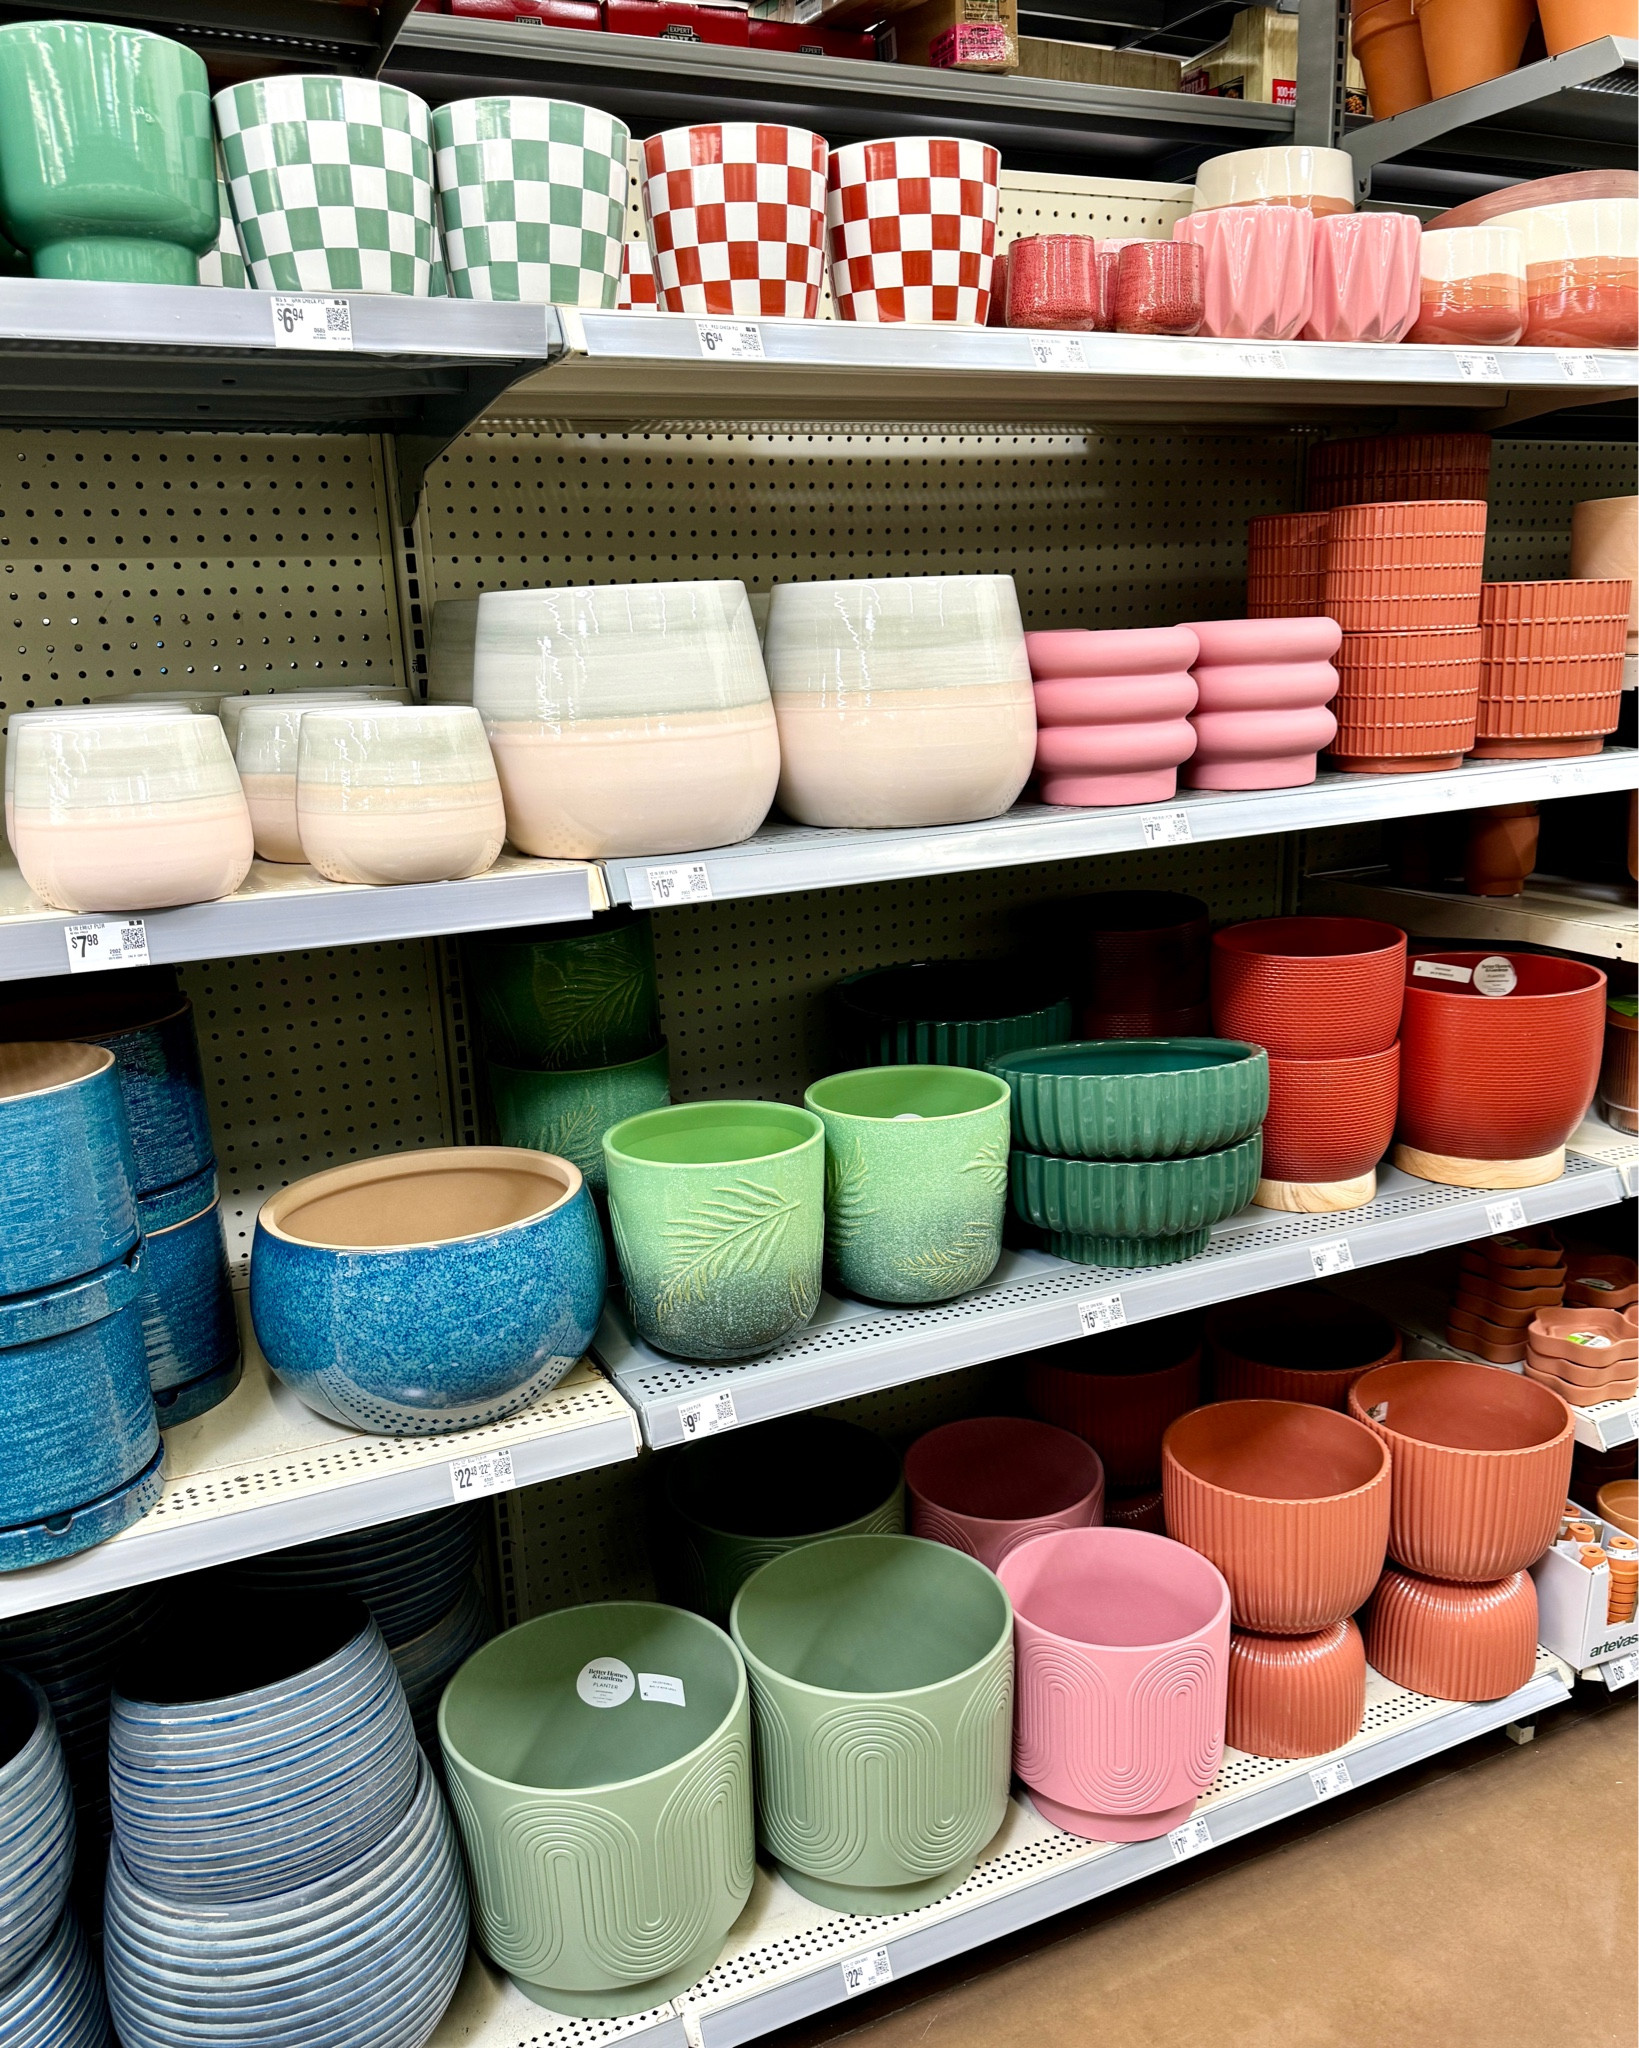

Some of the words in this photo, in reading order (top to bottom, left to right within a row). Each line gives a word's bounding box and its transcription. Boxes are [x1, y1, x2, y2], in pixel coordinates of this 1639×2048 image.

[669, 26, 691, 34] EXPERT
[589, 1668, 607, 1676] Better
[607, 1670, 628, 1679] Homes
